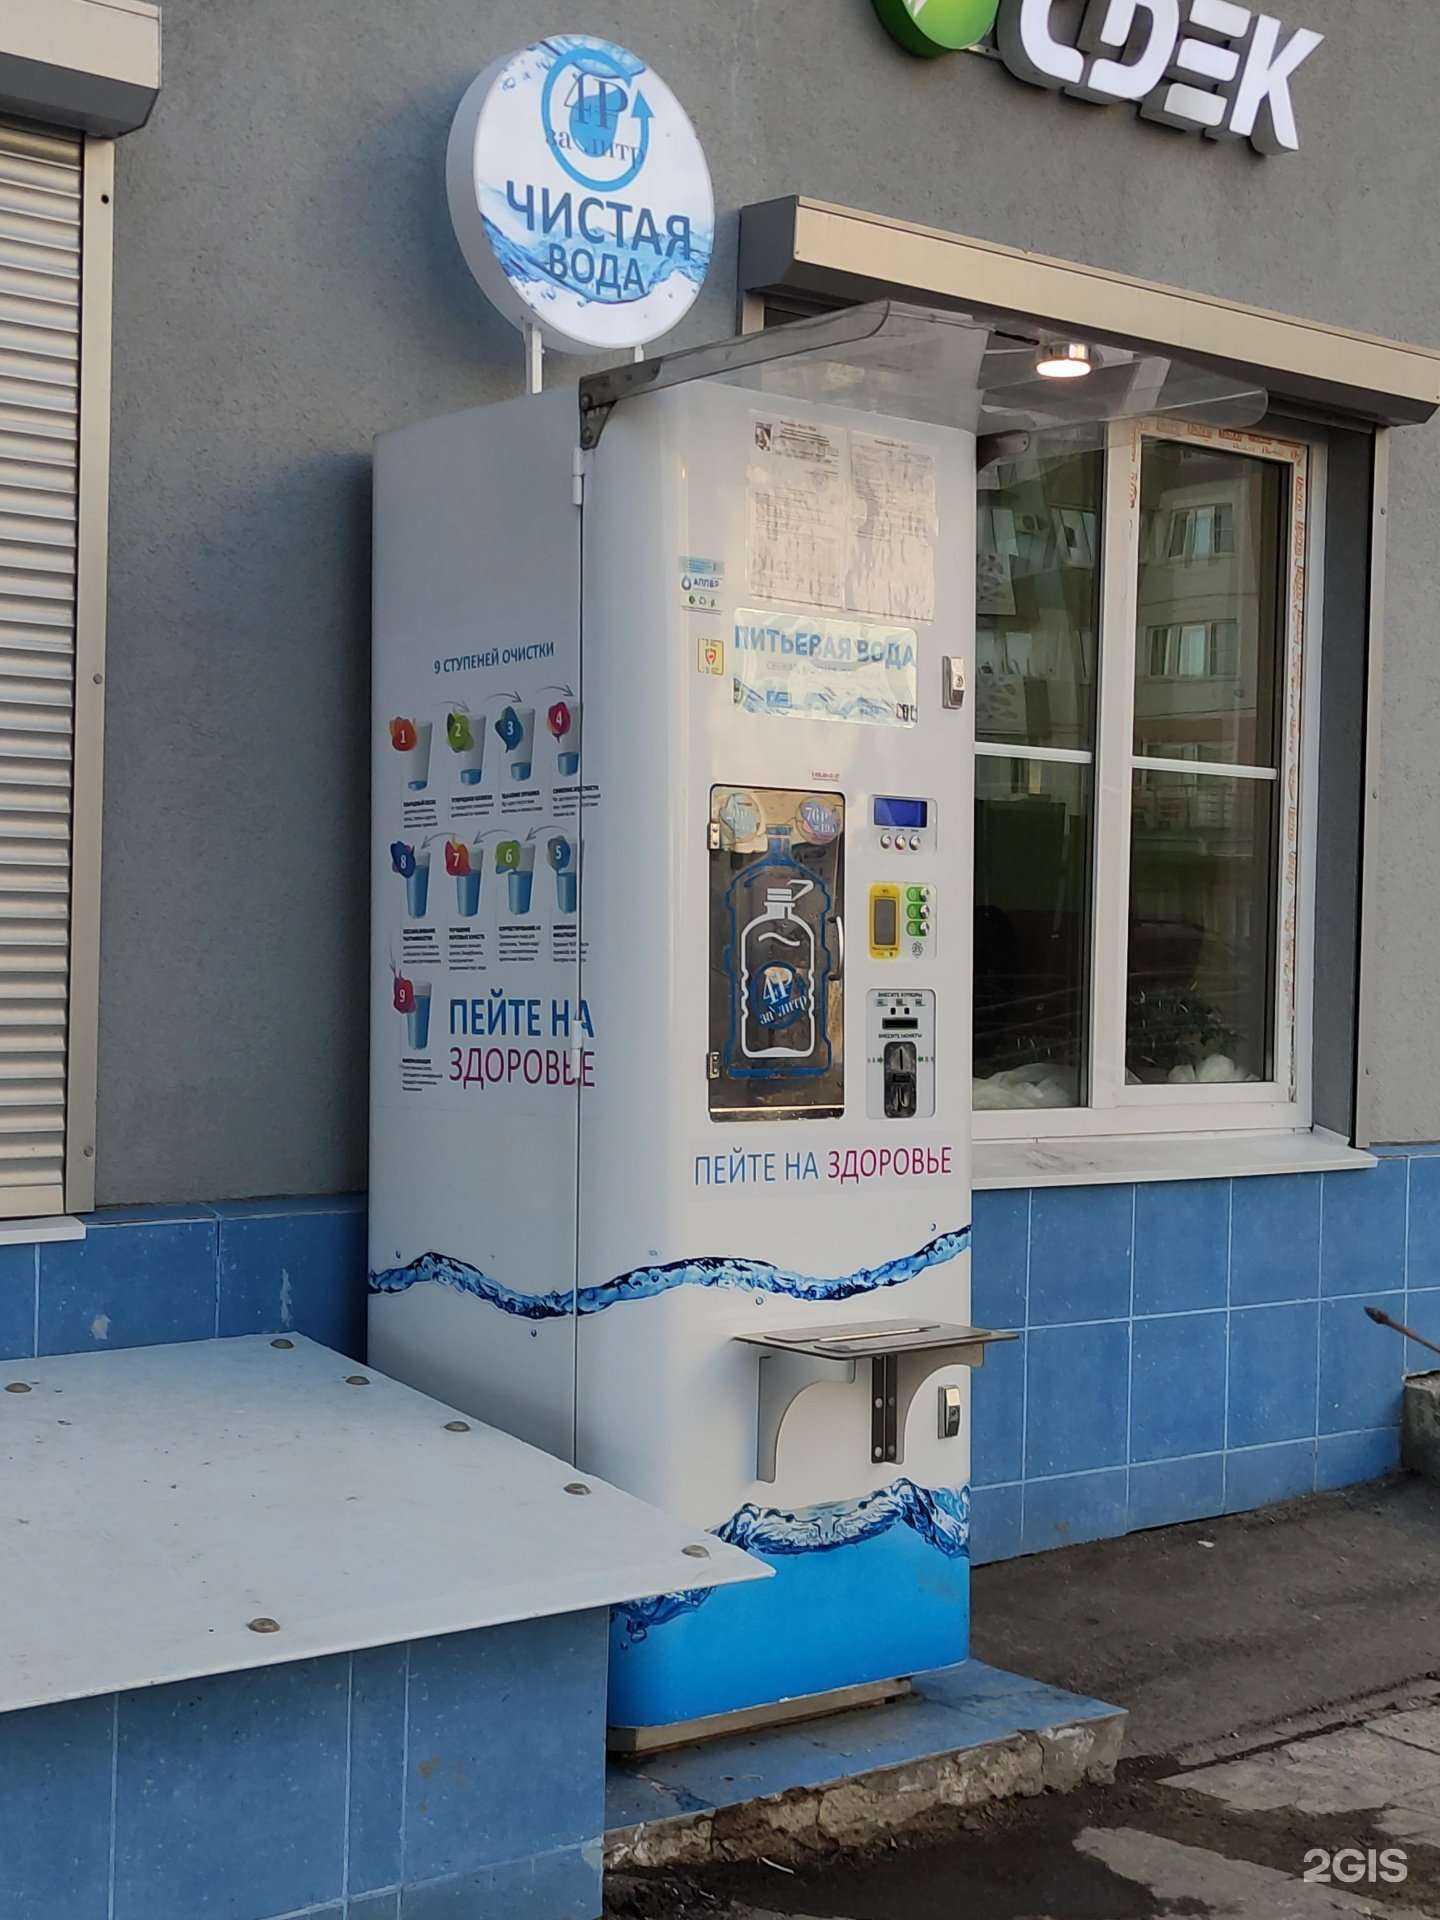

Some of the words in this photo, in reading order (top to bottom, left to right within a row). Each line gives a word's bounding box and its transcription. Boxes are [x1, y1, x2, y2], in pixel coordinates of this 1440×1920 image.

[506, 180, 691, 260] ЧИСТАЯ
[548, 242, 646, 298] ВОДА
[434, 660, 441, 674] 9
[443, 648, 500, 673] СТУПЕНЕЙ
[502, 641, 555, 664] ОЧИСТКИ
[856, 638, 914, 670] ВОДА
[555, 710, 563, 726] 4
[455, 724, 461, 737] 2
[506, 721, 514, 736] 3
[400, 730, 406, 743] 1
[453, 852, 460, 867] 7
[505, 848, 513, 863] 6
[555, 845, 562, 860] 5
[400, 854, 407, 869] 8
[399, 990, 406, 1003] 9
[450, 988, 541, 1036] ПЕЙТЕ
[552, 1000, 595, 1038] НА
[450, 1047, 596, 1090] ЗДОРОВЬЕ
[695, 1147, 776, 1186] ПЕЙТЕ
[785, 1151, 819, 1180] НА
[827, 1147, 952, 1185] ЗДОРОВЬЕ
